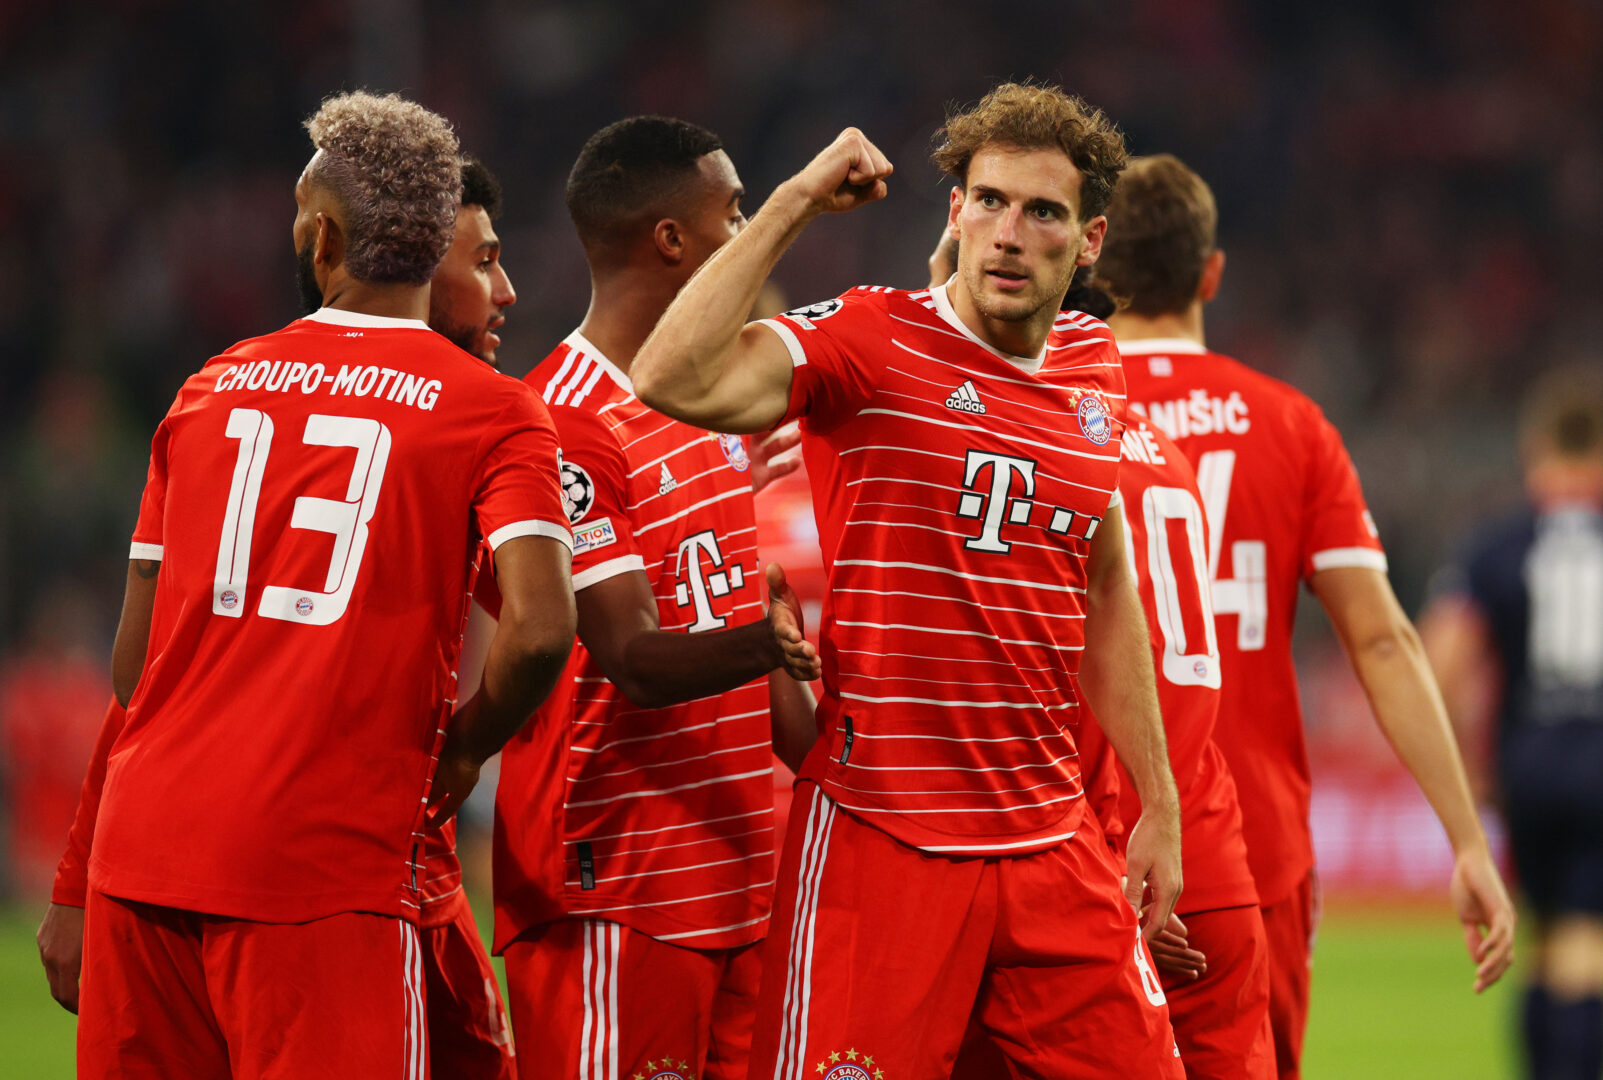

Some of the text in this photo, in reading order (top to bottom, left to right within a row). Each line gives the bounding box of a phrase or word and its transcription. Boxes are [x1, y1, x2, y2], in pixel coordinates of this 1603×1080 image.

[213, 360, 443, 411] CHOUPO-MOTING
[945, 397, 986, 414] adidas
[212, 407, 392, 626] 13
[1133, 924, 1167, 1007] 8
